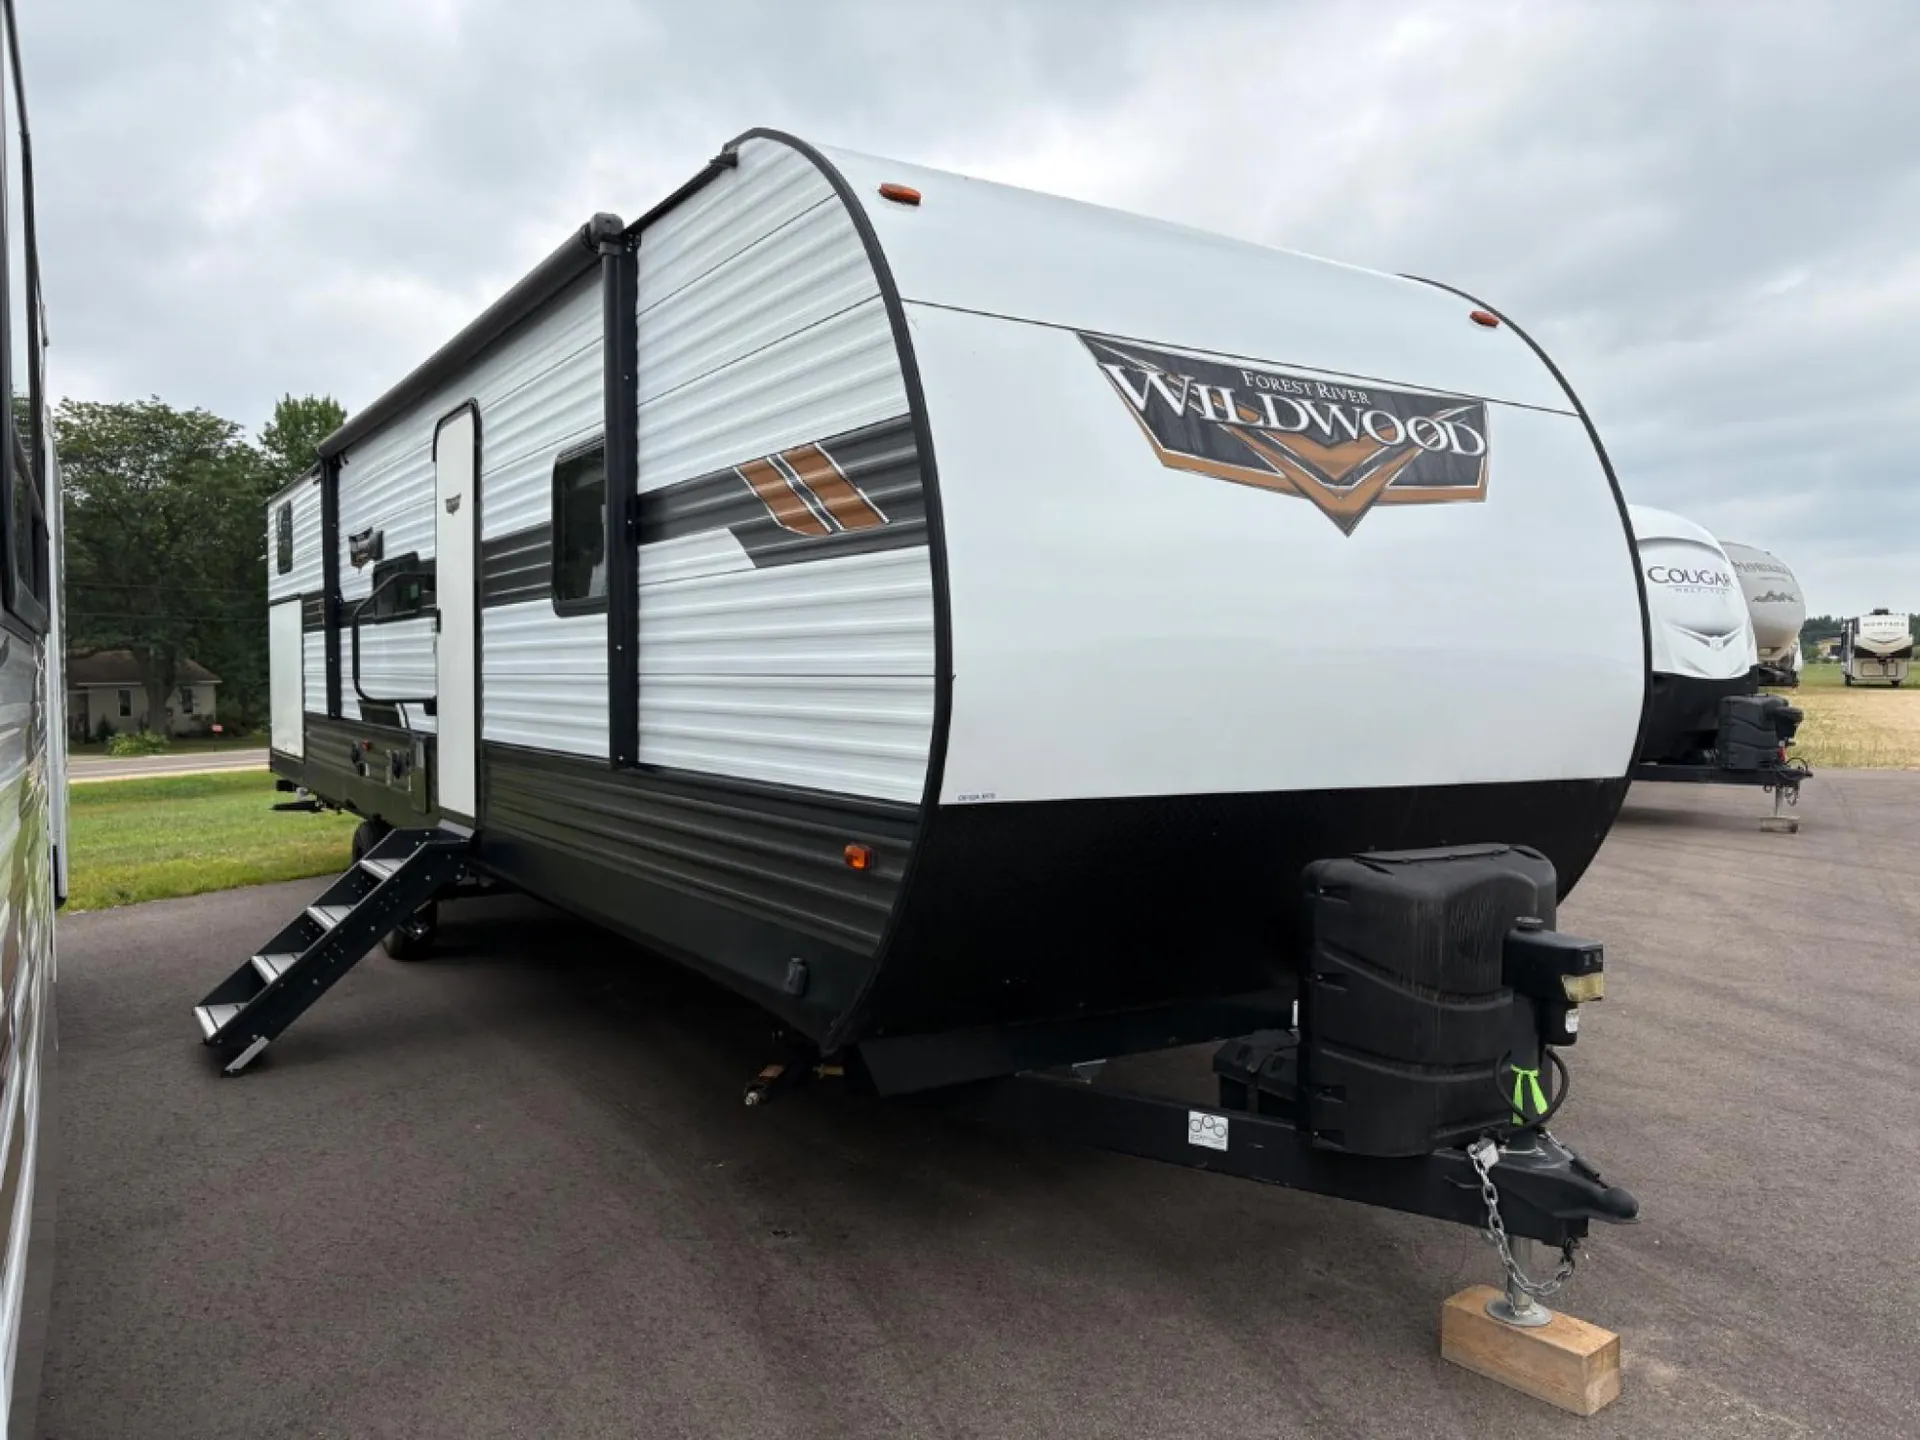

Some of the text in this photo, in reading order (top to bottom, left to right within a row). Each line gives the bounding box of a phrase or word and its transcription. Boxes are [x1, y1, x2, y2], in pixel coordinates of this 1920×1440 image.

[1240, 369, 1372, 406] FOREST RIVER
[1099, 362, 1488, 457] WILDWOOD
[1647, 565, 1735, 589] COUGAR
